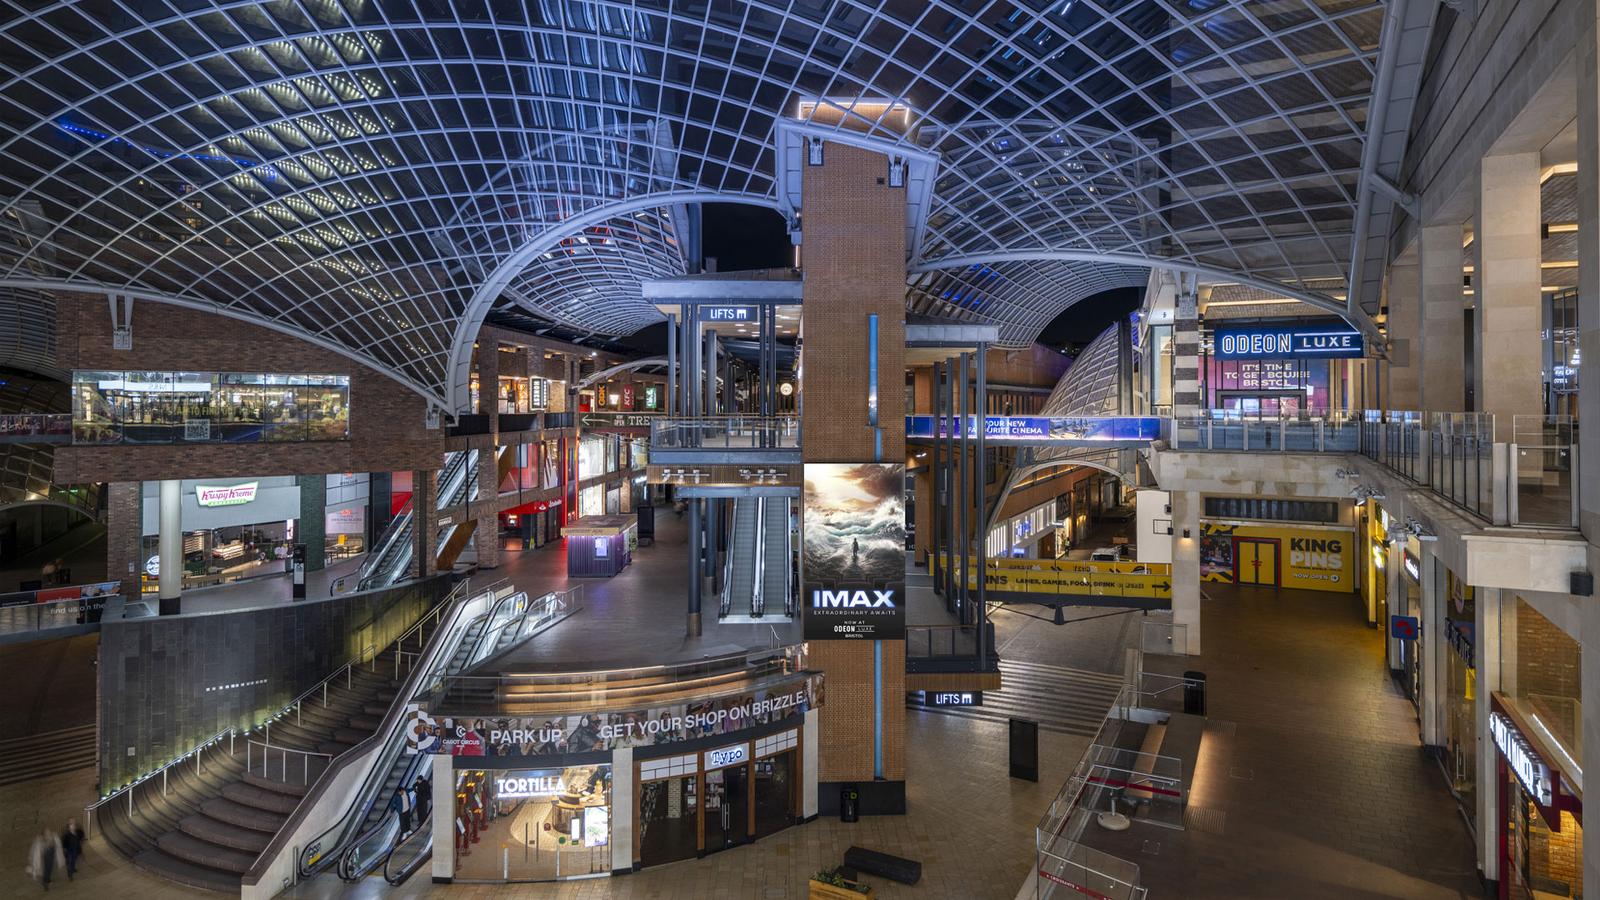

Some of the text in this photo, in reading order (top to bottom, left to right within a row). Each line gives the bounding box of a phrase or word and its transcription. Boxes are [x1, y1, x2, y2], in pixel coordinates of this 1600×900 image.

[711, 309, 734, 319] LIFTS
[1222, 333, 1351, 354] ODEON LUXE
[1265, 363, 1292, 371] TIME
[1243, 379, 1290, 387] BRSTOL
[1290, 538, 1342, 553] KING
[1290, 551, 1343, 569] PINS
[813, 590, 895, 608] IMAX
[834, 625, 855, 633] ODEON
[936, 693, 960, 704] LIFTS
[490, 729, 536, 744] PARK
[600, 723, 635, 739] GET
[639, 717, 682, 735] YOUR
[685, 709, 727, 729] SHOP
[730, 704, 750, 721] ON
[712, 749, 743, 765] Typo
[497, 778, 565, 793] TORTILLA
